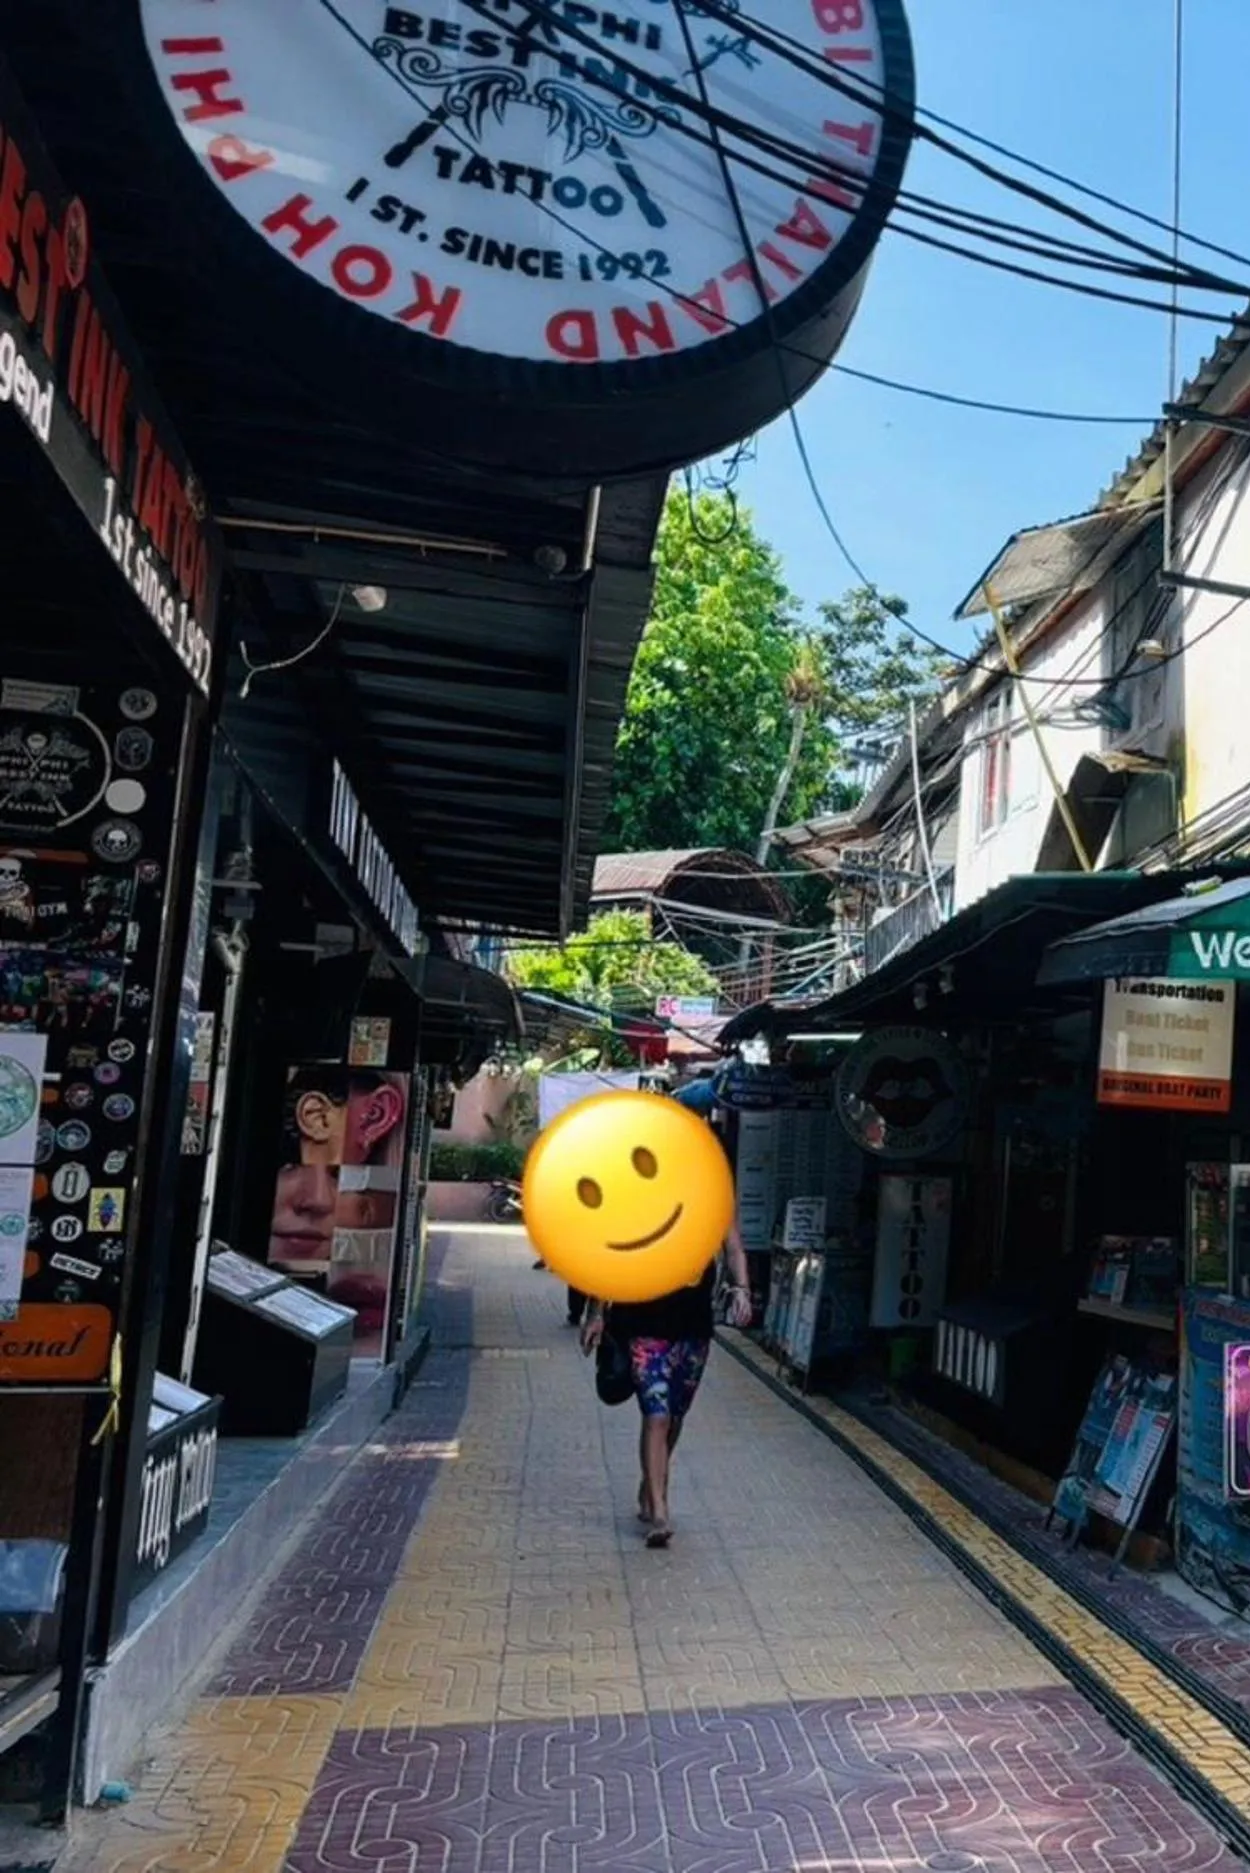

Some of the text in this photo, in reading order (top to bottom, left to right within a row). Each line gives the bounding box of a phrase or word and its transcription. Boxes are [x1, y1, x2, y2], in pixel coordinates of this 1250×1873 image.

[383, 7, 533, 68] BEST
[160, 36, 462, 337] KOH PHI
[433, 144, 625, 217] TATTOO
[440, 226, 564, 280] SINCE
[578, 248, 673, 282] 1992
[0, 134, 66, 358] EST
[68, 287, 131, 476] INK
[100, 476, 212, 698] 1st since 1992
[1113, 978, 1225, 1003] Transportation
[1125, 1009, 1210, 1034] Boat Ticket
[1157, 1042, 1204, 1064] Ticket
[1157, 1081, 1186, 1097] BOAT
[1187, 1083, 1223, 1101] PARTY
